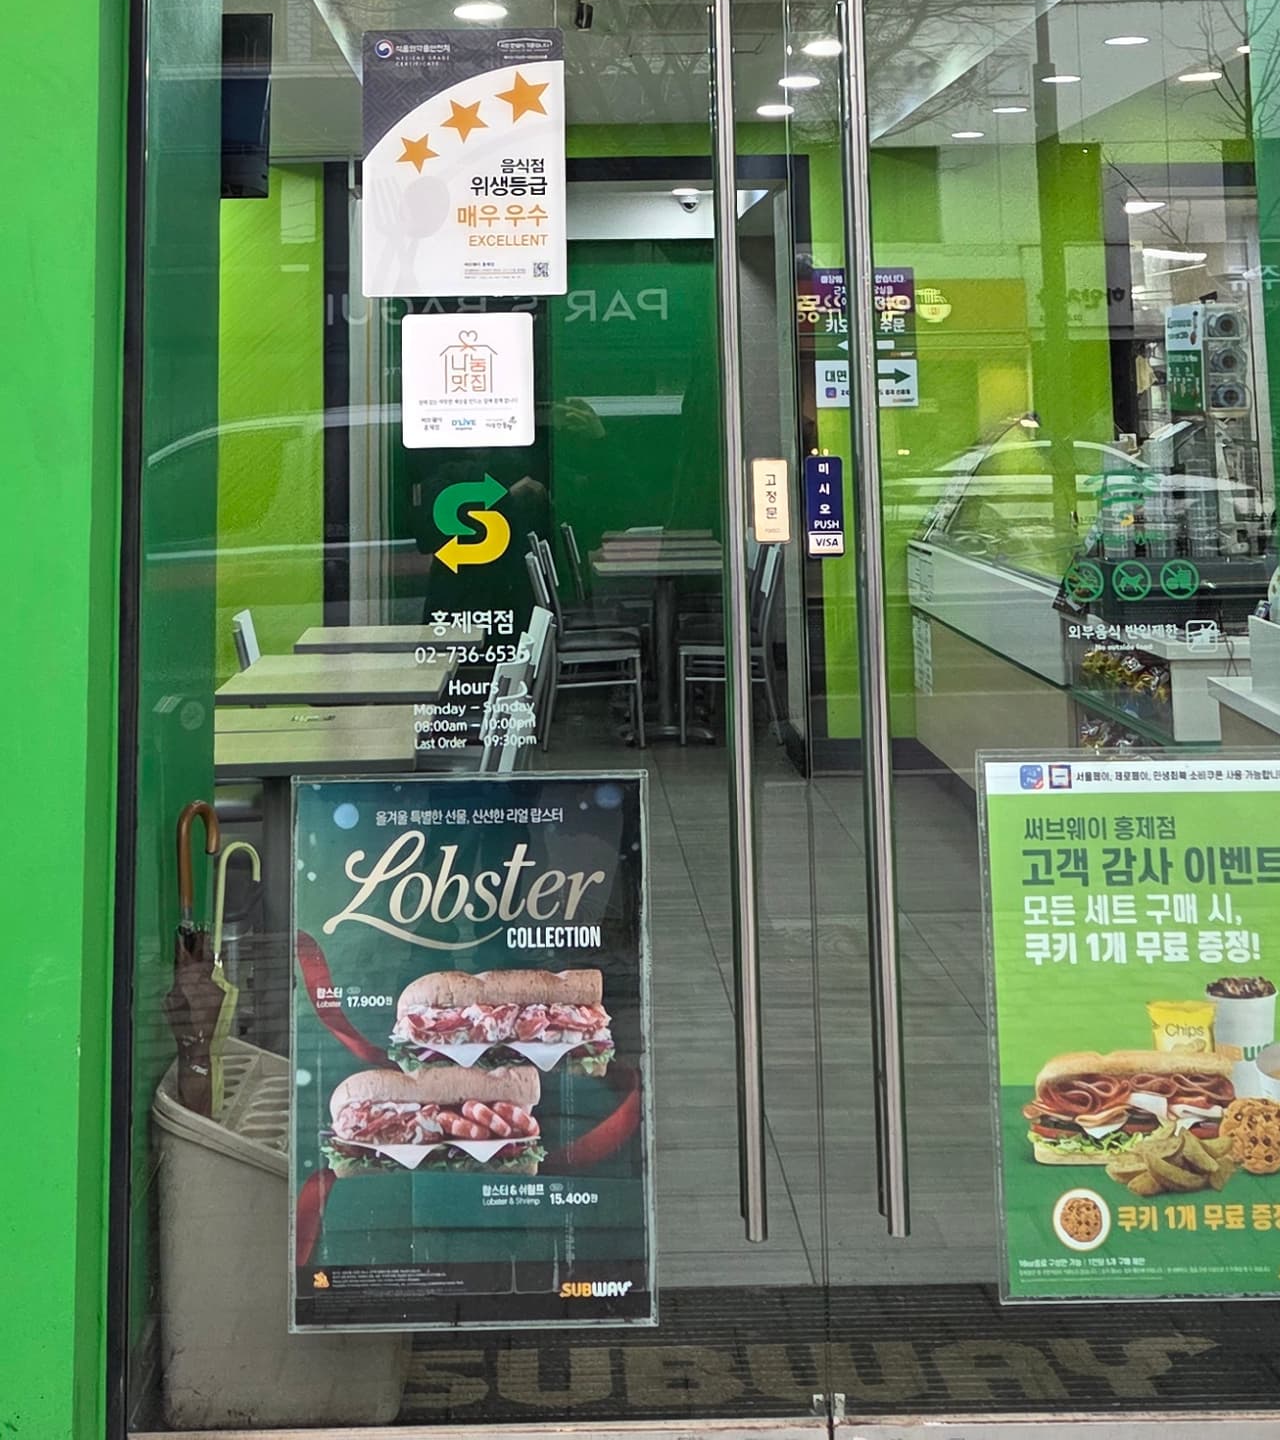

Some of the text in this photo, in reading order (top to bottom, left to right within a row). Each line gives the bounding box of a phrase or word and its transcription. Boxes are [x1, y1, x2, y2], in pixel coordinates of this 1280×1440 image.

[500, 158, 544, 174] 음식점
[470, 176, 548, 197] 위생등급
[457, 204, 548, 228] 매우 우수
[469, 234, 548, 247] EXCELLENT
[451, 354, 486, 372] 나눔
[451, 374, 486, 393] 맛집
[814, 520, 840, 529] PUSH
[816, 538, 839, 547] VISA
[429, 610, 514, 636] 홍제역점
[1068, 623, 1179, 640] 외부음식 반입제한
[449, 679, 498, 696] Hours
[414, 700, 535, 718] Monday Sunday
[414, 718, 536, 733] 08:00am 10:00pm
[414, 734, 537, 750] Last Order 09:30pm
[1225, 769, 1242, 780] 사용
[376, 807, 563, 826] 올겨울 특별한 선물, 신선한 리얼 랍스터
[1024, 815, 1176, 841] 써브웨이 홍제점
[1022, 848, 1089, 887] 고객
[1102, 847, 1173, 886] 감사
[323, 830, 606, 951] Lobster
[1023, 892, 1243, 927] 모든 세트 구매 시,
[506, 925, 602, 949] COLLECTION
[1025, 930, 1261, 965] 쿠키 1개 무료 증정!
[347, 995, 393, 1008] 17,900원
[1164, 1022, 1205, 1040] Chips
[482, 1184, 509, 1197] 랍스터
[510, 1184, 517, 1196] &
[1117, 1208, 1158, 1231] 쿠키
[1165, 1207, 1198, 1231] 1개
[1203, 1205, 1246, 1230] 무료
[559, 1280, 633, 1298] SUBWAY
